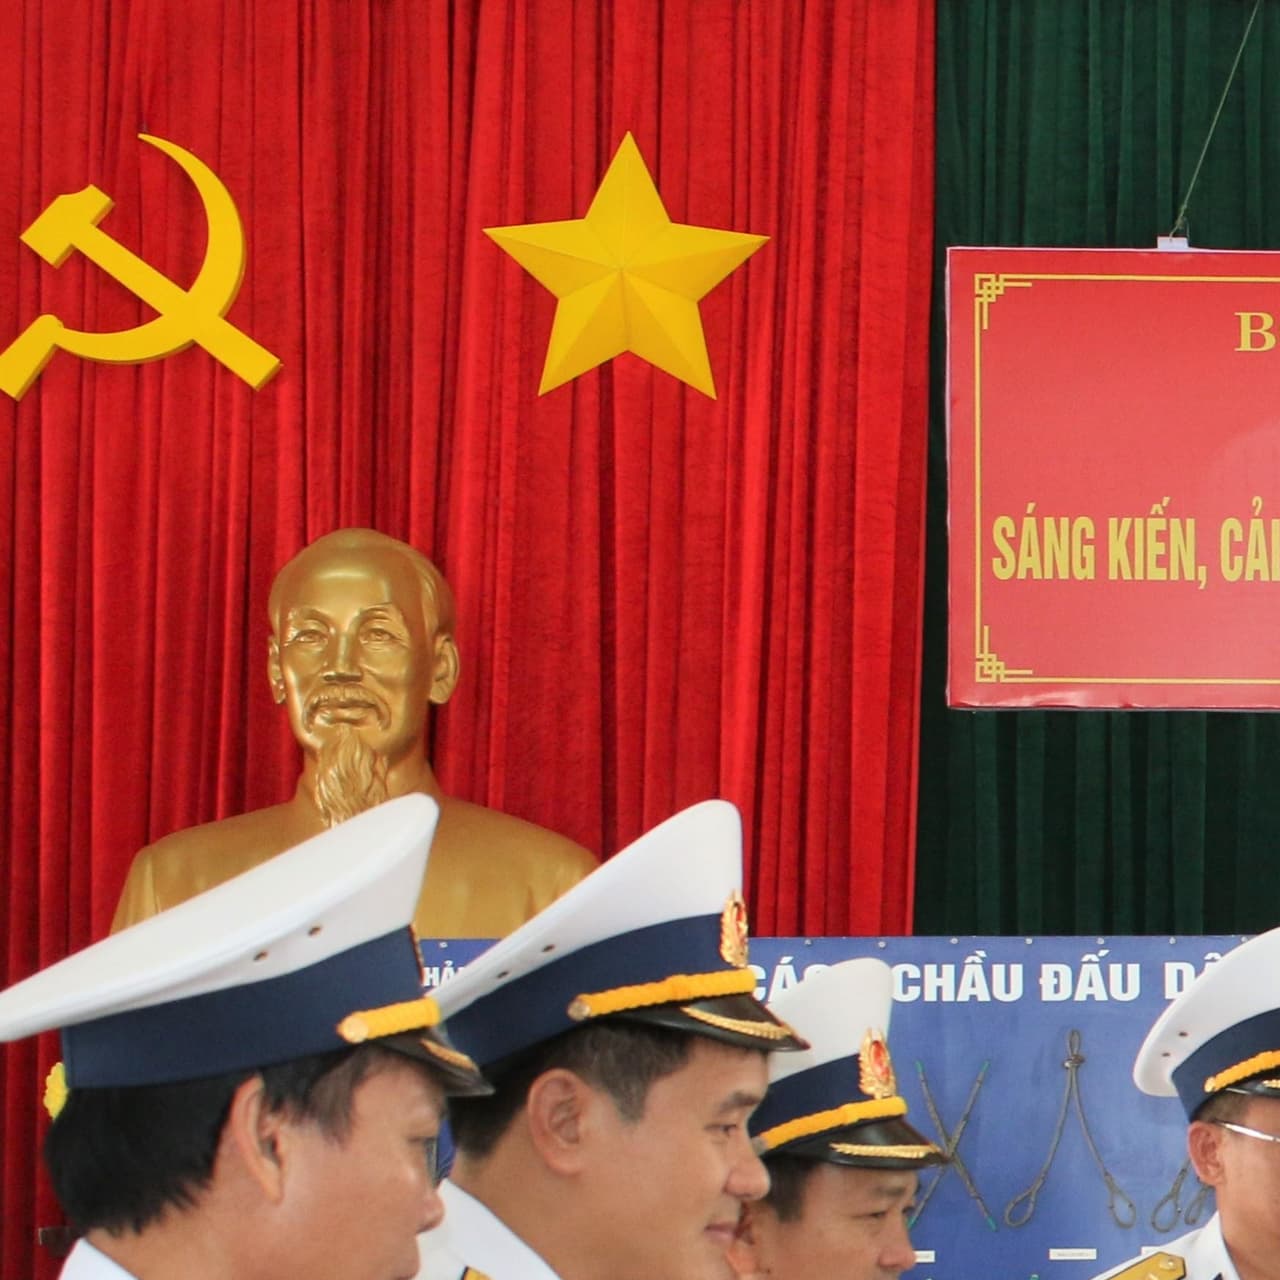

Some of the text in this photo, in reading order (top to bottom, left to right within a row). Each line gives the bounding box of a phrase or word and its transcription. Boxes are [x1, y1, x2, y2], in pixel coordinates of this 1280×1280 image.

[991, 502, 1096, 581] SÁNG
[1107, 495, 1208, 590] KIẾN,
[422, 960, 465, 987] HẢ
[889, 951, 1024, 1002] CHẦU
[1040, 950, 1141, 1002] ĐẤU
